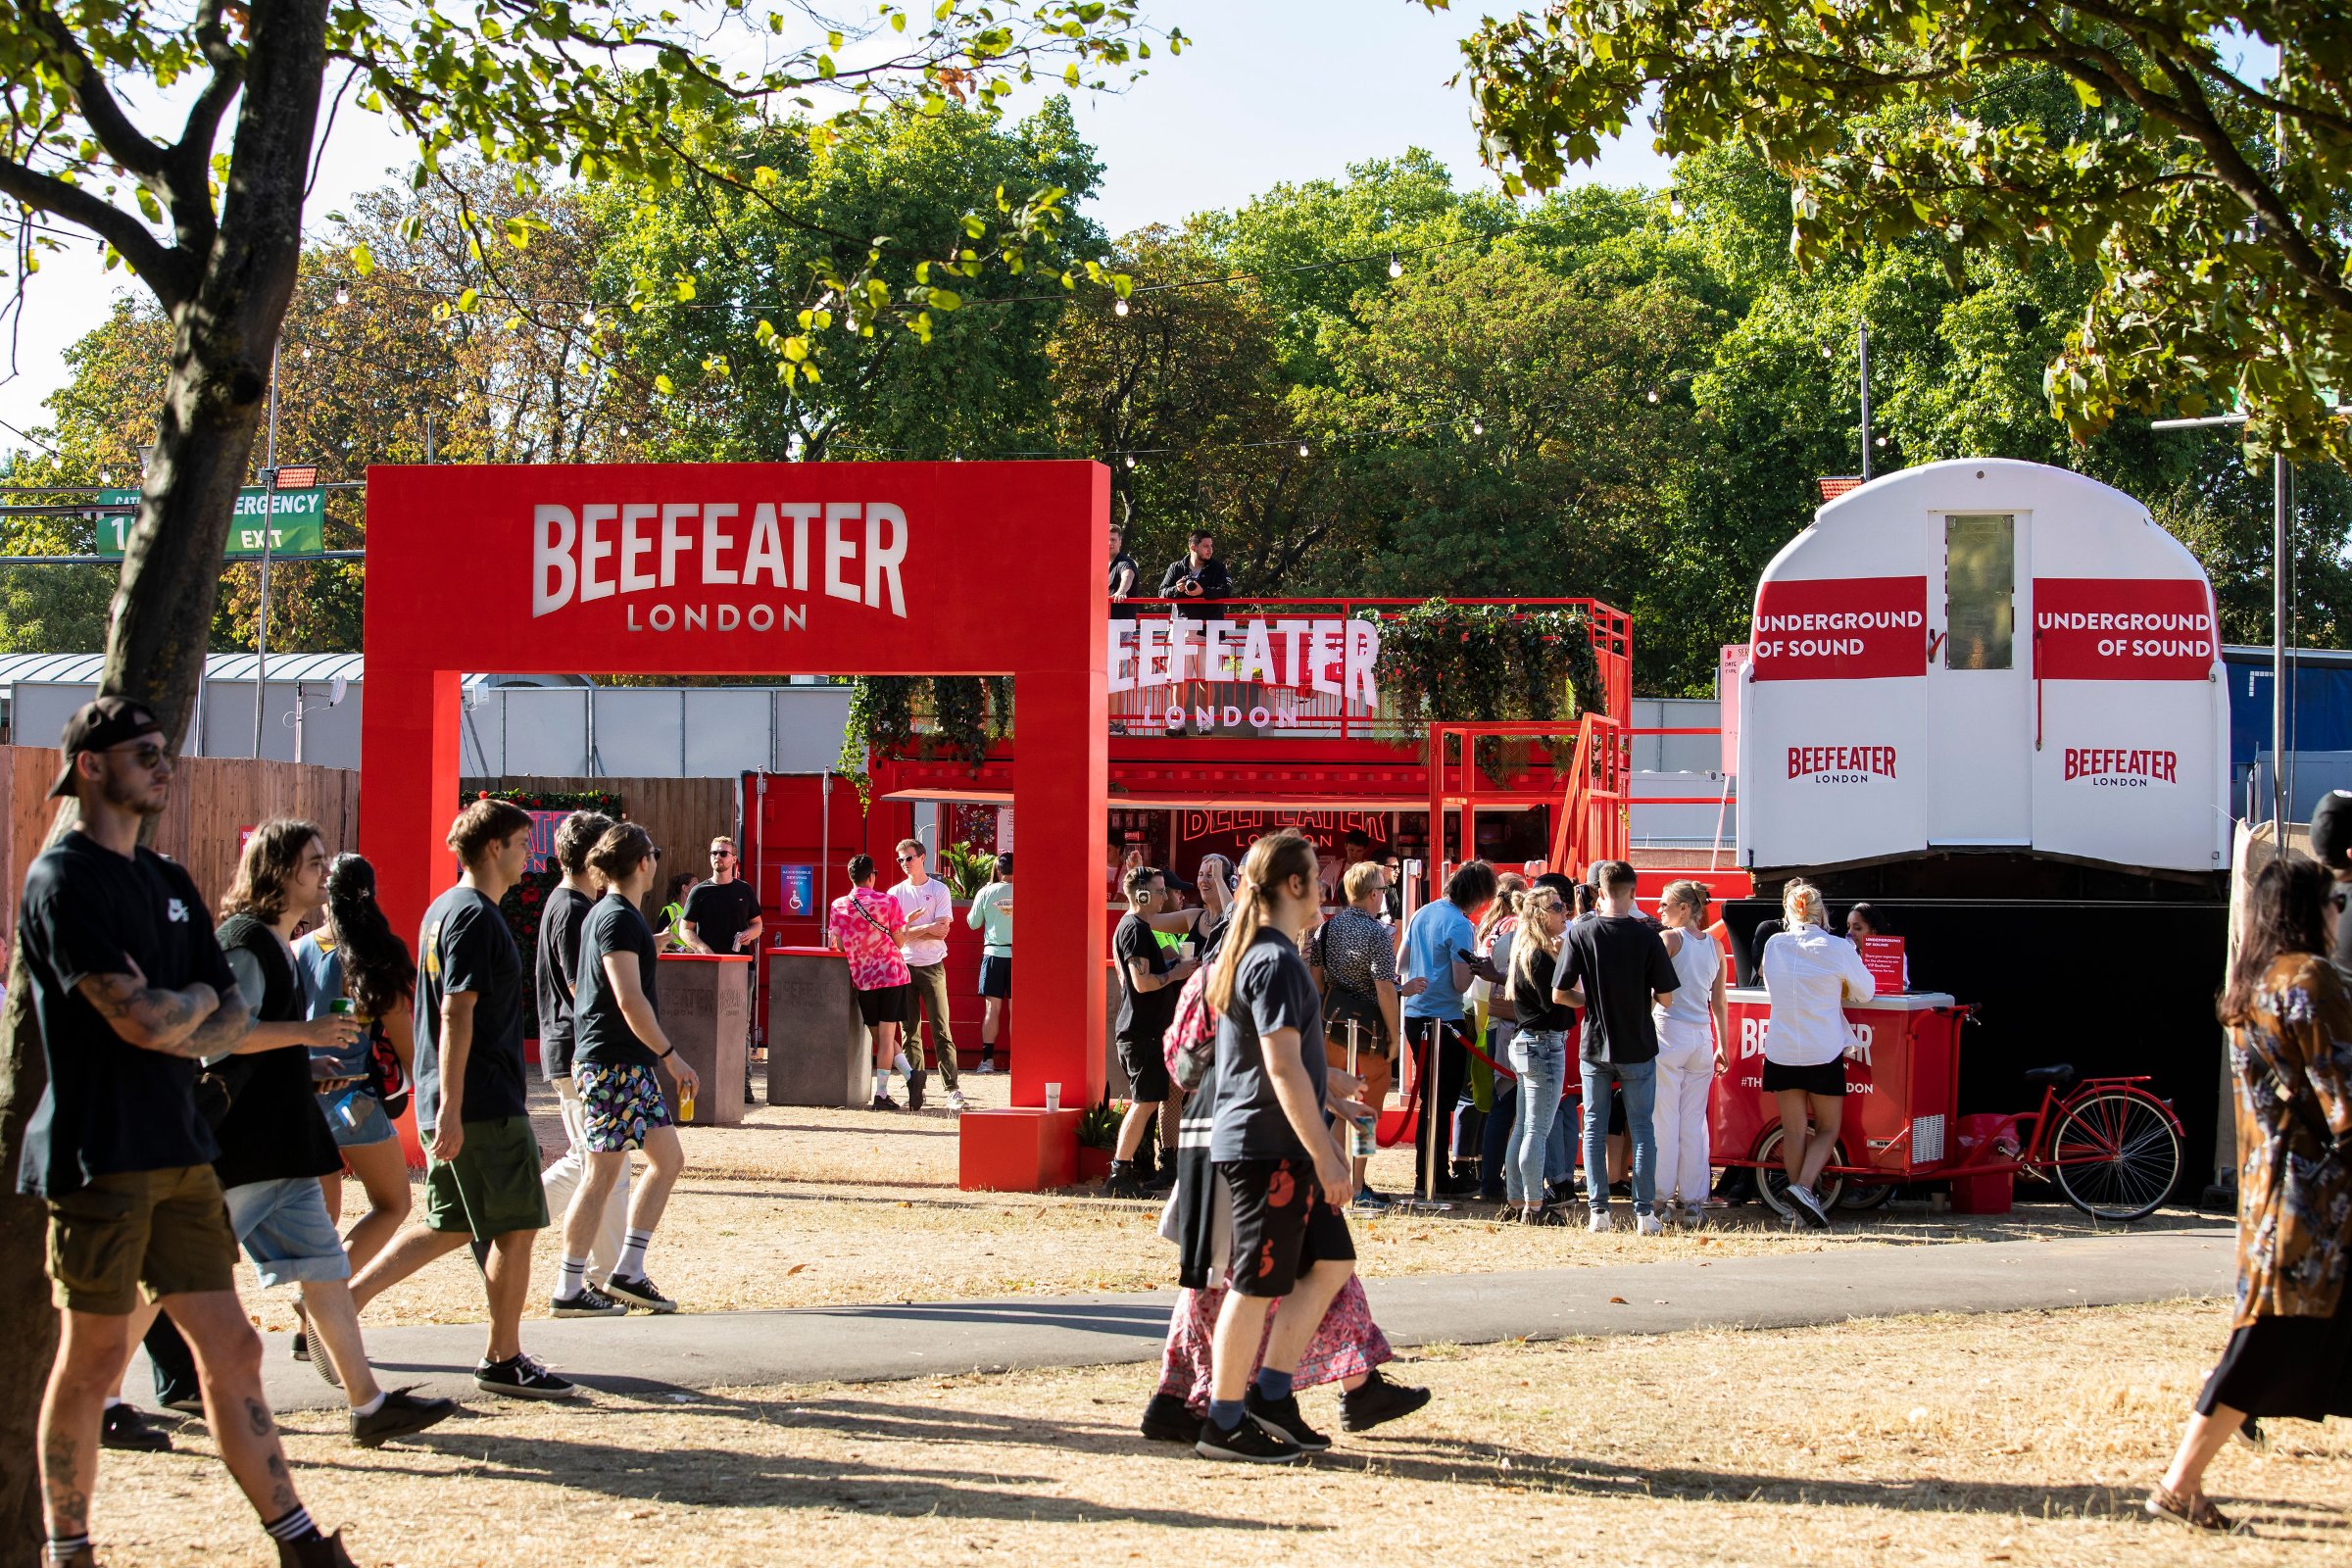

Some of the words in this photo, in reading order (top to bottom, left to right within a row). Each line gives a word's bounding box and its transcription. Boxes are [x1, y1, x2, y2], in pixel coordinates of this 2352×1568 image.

[532, 502, 908, 619] BEEFEATER
[627, 604, 807, 632] LONDON
[1756, 611, 1923, 632] UNDERGROUND
[2037, 612, 2211, 631] UNDERGROUND
[1755, 640, 1784, 658] OF
[1788, 638, 1864, 658] SOUND
[2097, 639, 2128, 657] OF
[2132, 640, 2211, 658] SOUND
[1108, 618, 1379, 708] EEFEATER
[1144, 705, 1298, 729] LONDON
[1788, 746, 1896, 780] BEEFEATER
[2064, 748, 2177, 785] BEEFEATER
[1815, 774, 1868, 784] LONDON
[2092, 777, 2147, 787] LONDON
